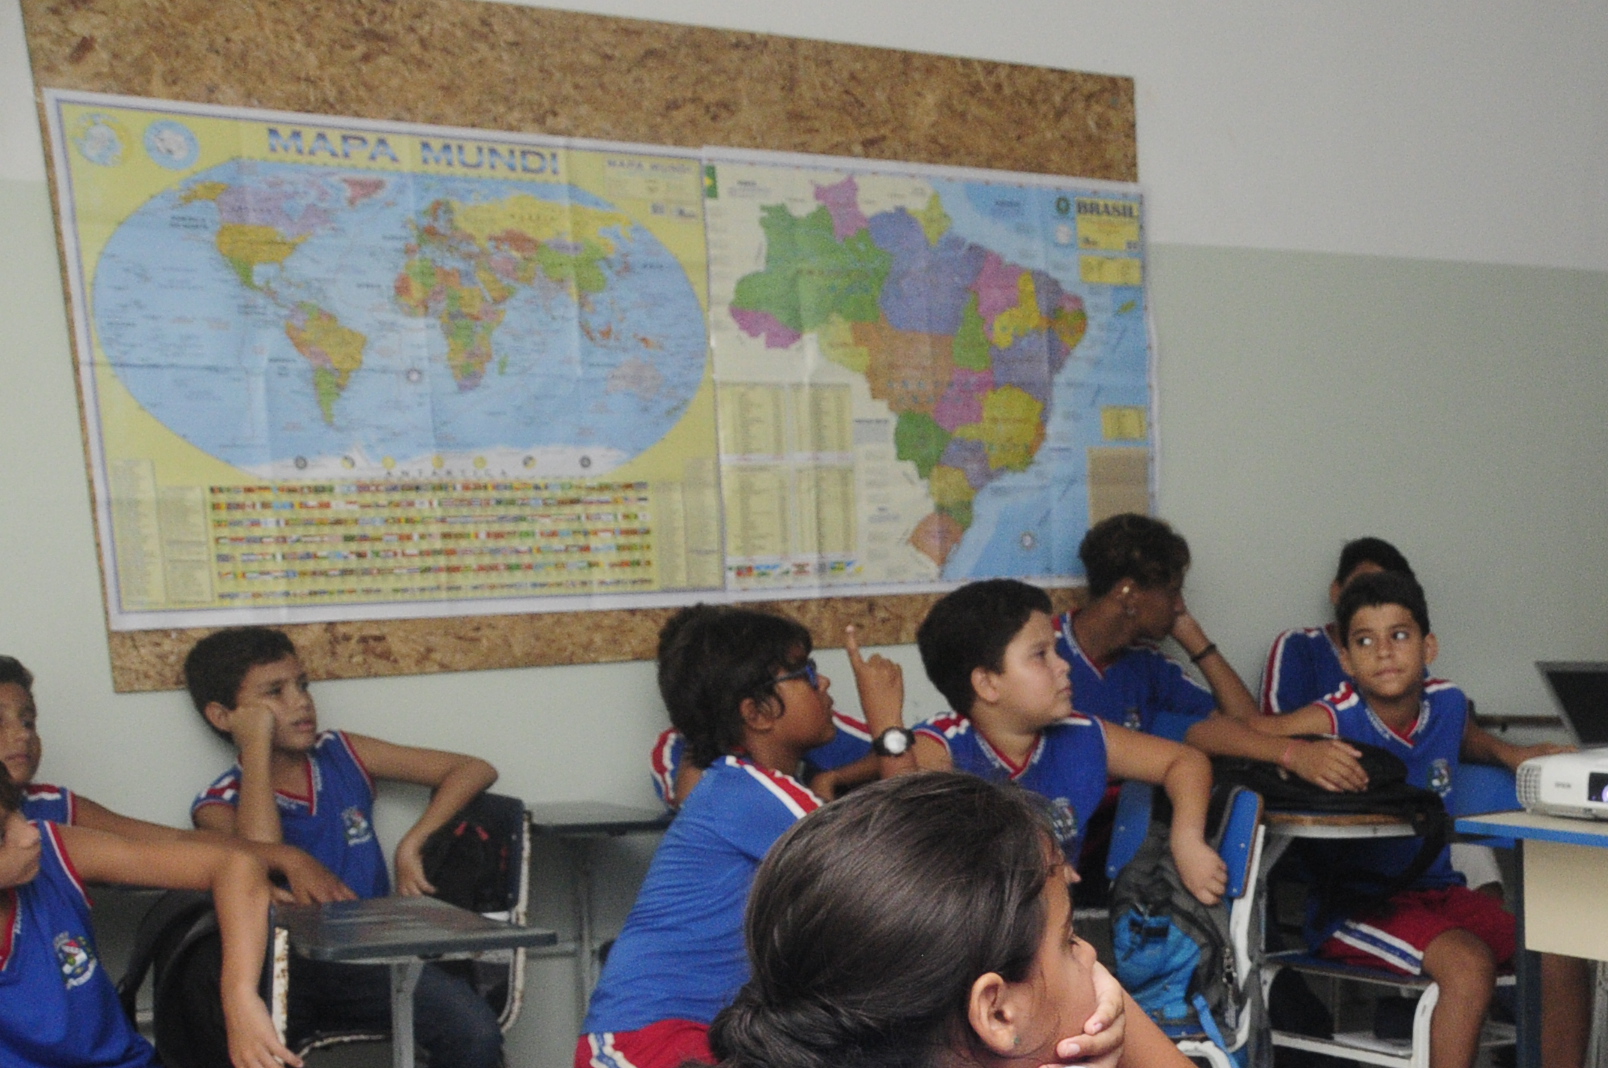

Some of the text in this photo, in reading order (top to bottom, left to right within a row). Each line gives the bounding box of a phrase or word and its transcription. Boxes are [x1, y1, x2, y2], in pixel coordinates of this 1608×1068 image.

[268, 127, 560, 175] MAPA MUNDI
[1077, 200, 1138, 219] BRASIL
